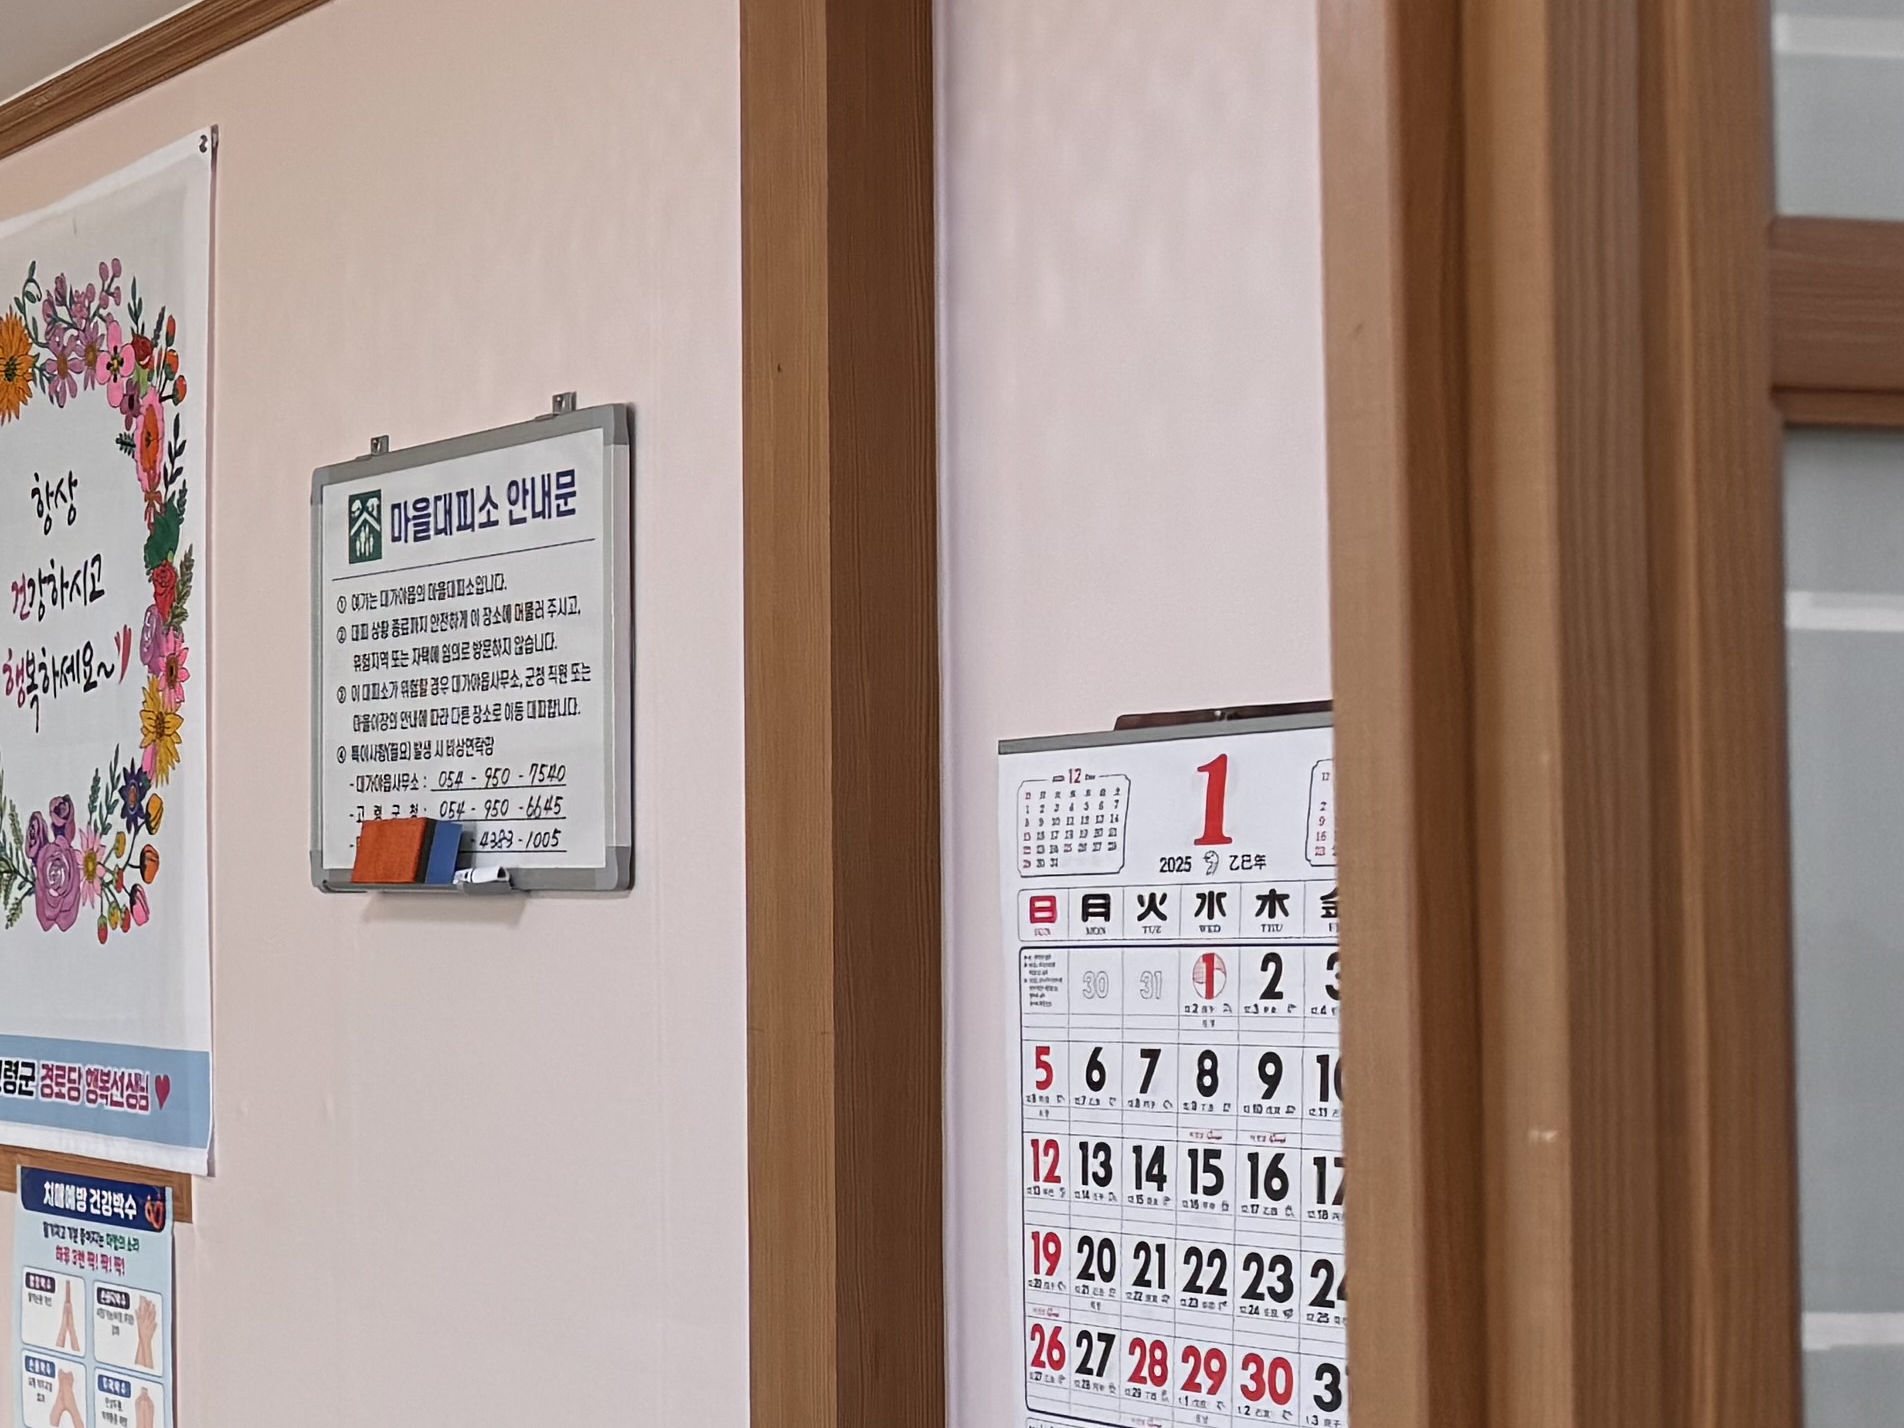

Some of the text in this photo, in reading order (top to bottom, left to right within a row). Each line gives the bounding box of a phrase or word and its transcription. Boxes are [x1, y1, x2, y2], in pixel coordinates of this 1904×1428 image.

[31, 470, 78, 535] 항상
[391, 469, 577, 543] 마을대피소 안내문
[11, 553, 105, 621] 건강하시고
[1069, 768, 1081, 784] 12
[1194, 753, 1232, 845] 1
[1160, 856, 1192, 873] 2025
[1029, 895, 1057, 924] 日
[1082, 894, 1111, 922] 月
[1137, 892, 1167, 921] 火
[1194, 891, 1227, 920] 水
[1255, 888, 1290, 918] 木
[1260, 952, 1283, 999] 2
[41, 1063, 81, 1102] 경로당
[85, 1067, 149, 1112] 행복선생님
[1035, 1046, 1053, 1090] 5
[1086, 1047, 1106, 1092] 6
[1140, 1048, 1161, 1094] 7
[1197, 1050, 1219, 1097] 8
[1258, 1051, 1283, 1099] 9
[1031, 1139, 1061, 1183] 12
[1079, 1141, 1112, 1187] 13
[1133, 1145, 1167, 1191] 14
[1188, 1149, 1224, 1196] 15
[1247, 1152, 1289, 1201] 16
[43, 1180, 137, 1220] 치매예방 건강박수
[1031, 1231, 1061, 1276] 19
[1077, 1235, 1116, 1283] 20
[1132, 1241, 1166, 1289] 21
[1182, 1246, 1227, 1296] 22
[1241, 1252, 1293, 1303] 23
[1031, 1323, 1293, 1405] 26 27 28 29 30
